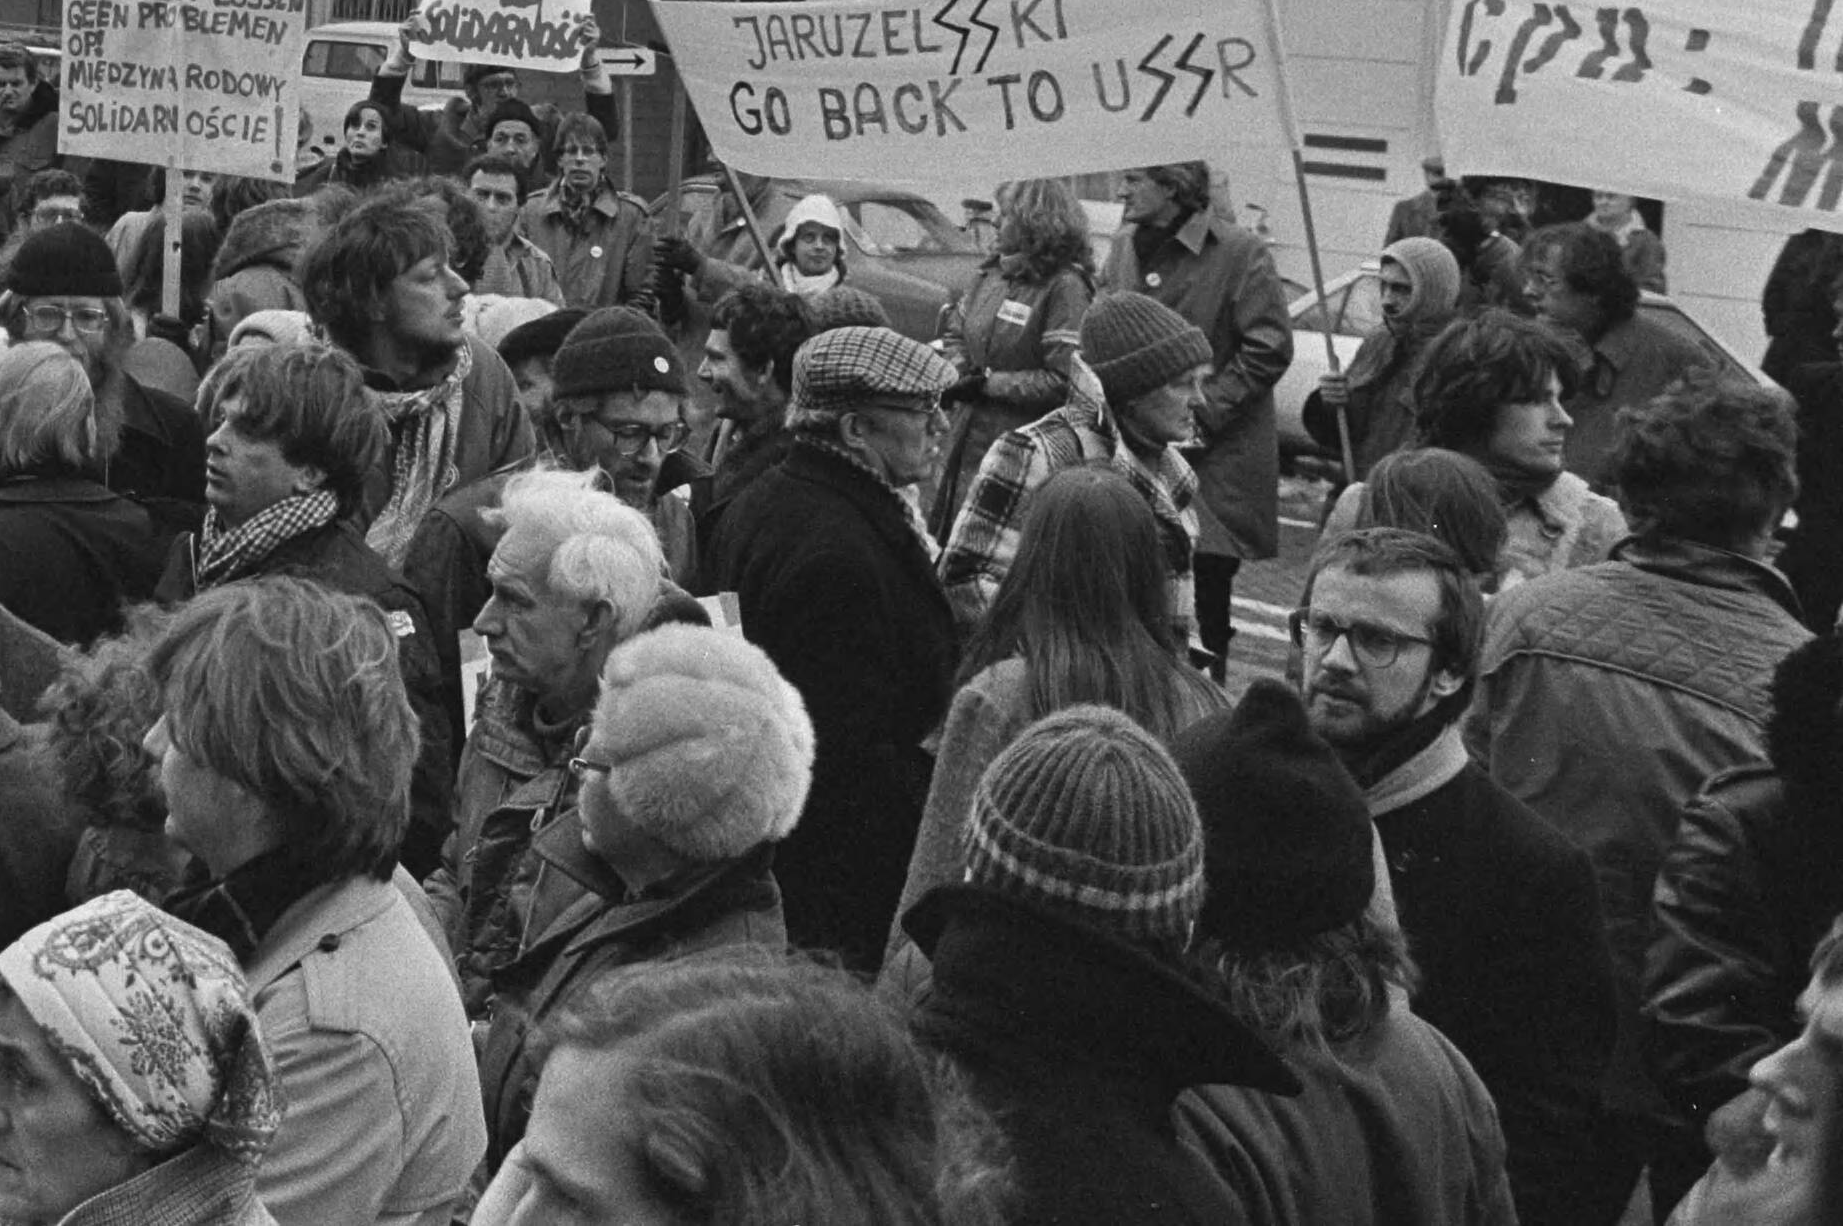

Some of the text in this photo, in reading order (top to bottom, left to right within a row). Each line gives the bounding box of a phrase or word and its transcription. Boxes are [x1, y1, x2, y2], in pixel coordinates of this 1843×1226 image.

[68, 0, 129, 29] GEEN
[729, 32, 1257, 140] GO BACK TO USSR
